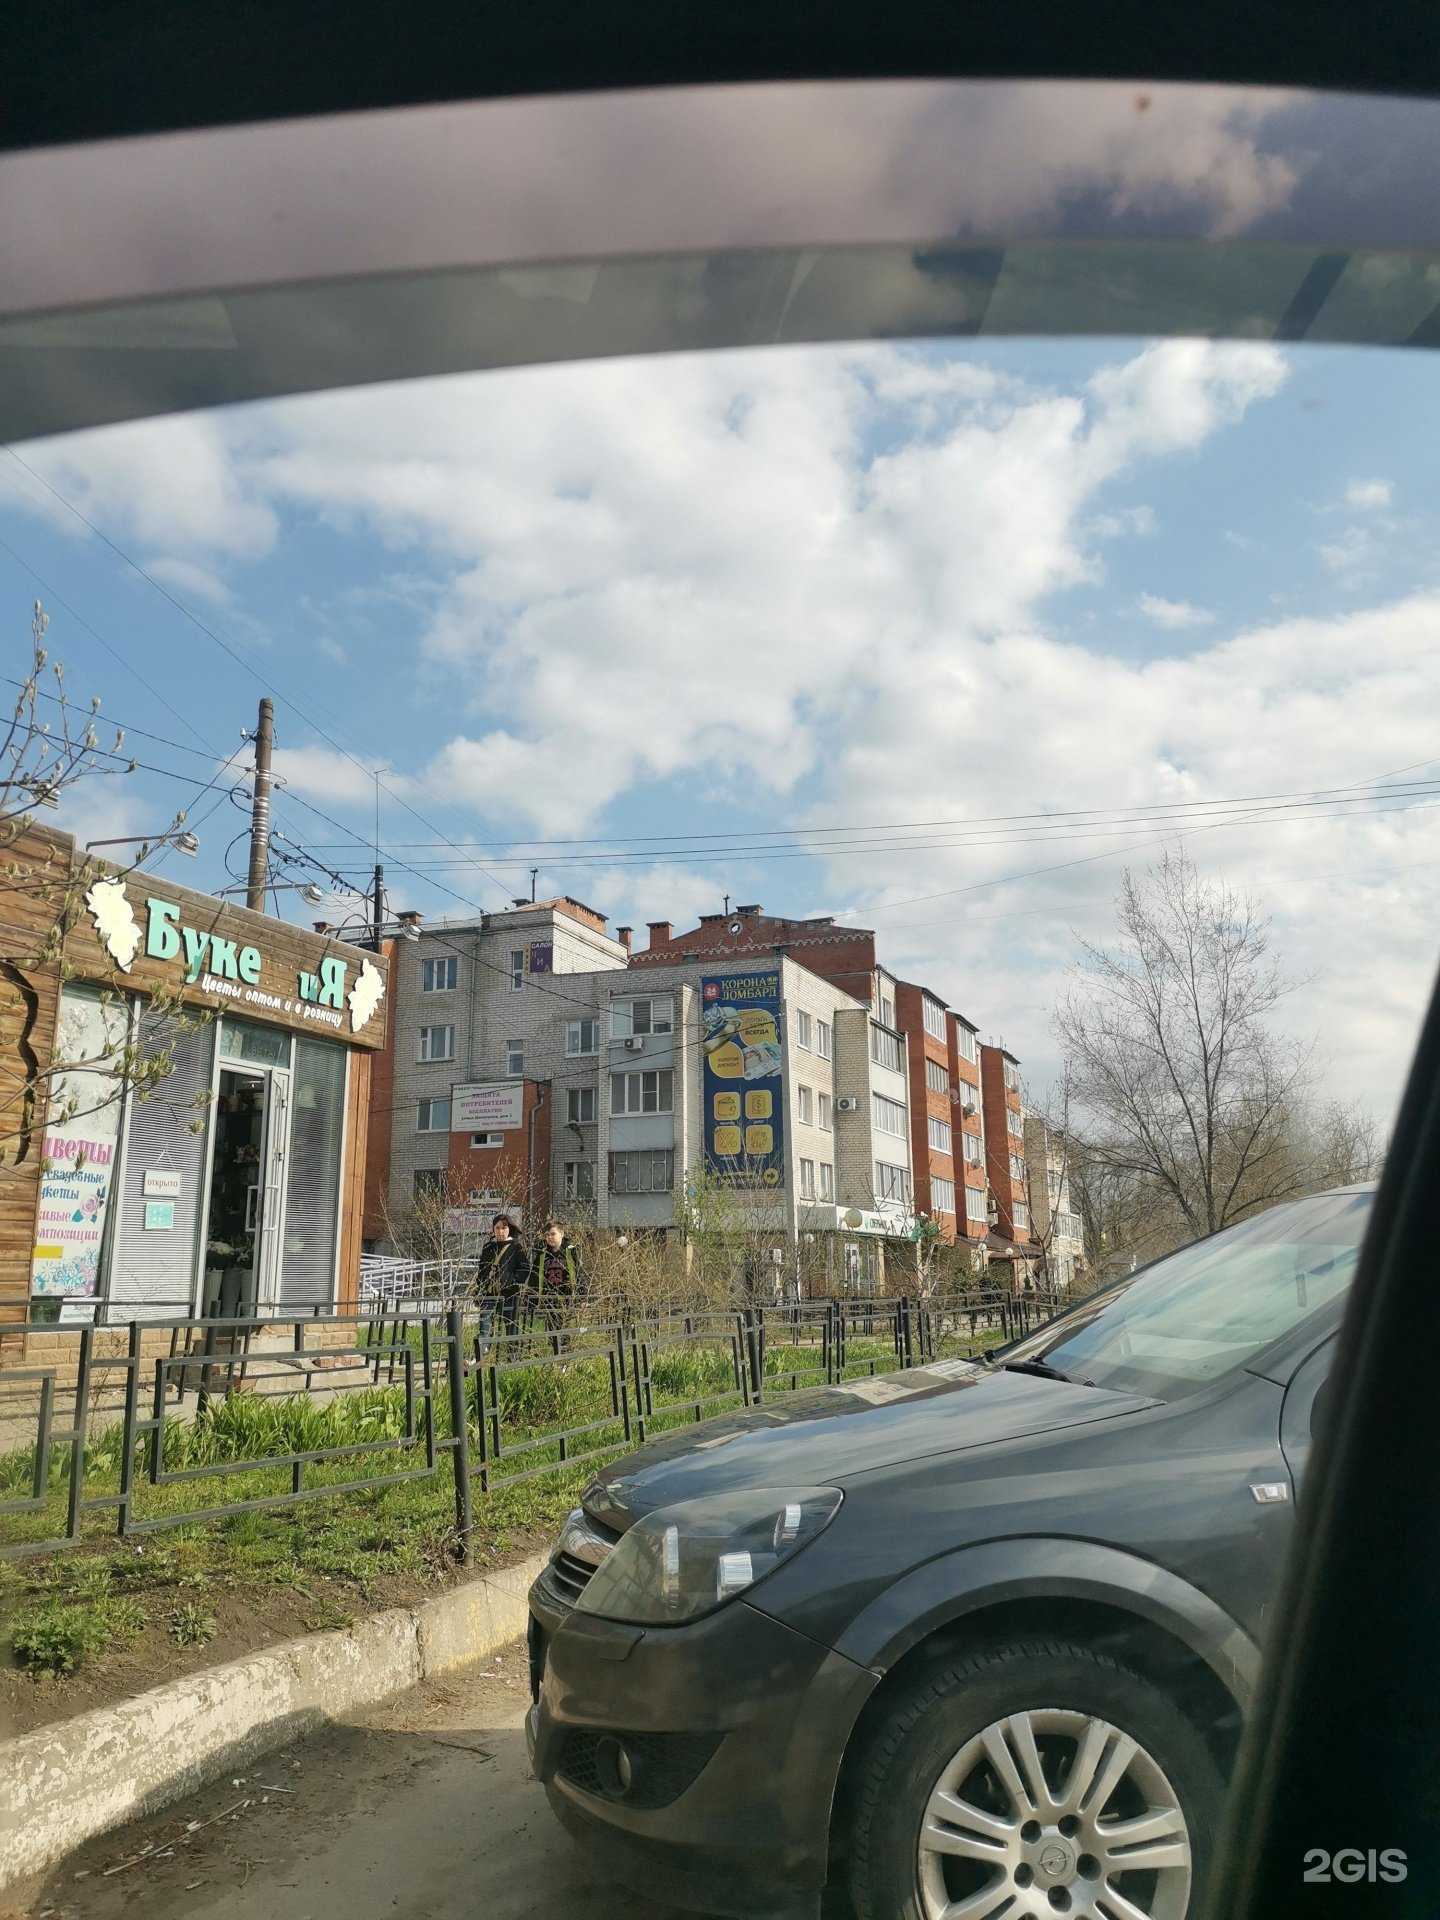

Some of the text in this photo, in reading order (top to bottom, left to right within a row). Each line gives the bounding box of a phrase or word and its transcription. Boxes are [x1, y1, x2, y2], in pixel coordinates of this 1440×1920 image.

[721, 977, 766, 989] КОРОНА
[722, 987, 777, 1000] ЛОМБАРД
[202, 974, 343, 1028] Цветы оптом и в розницу
[147, 1179, 178, 1189] открыто
[37, 1227, 99, 1243] мпозиции
